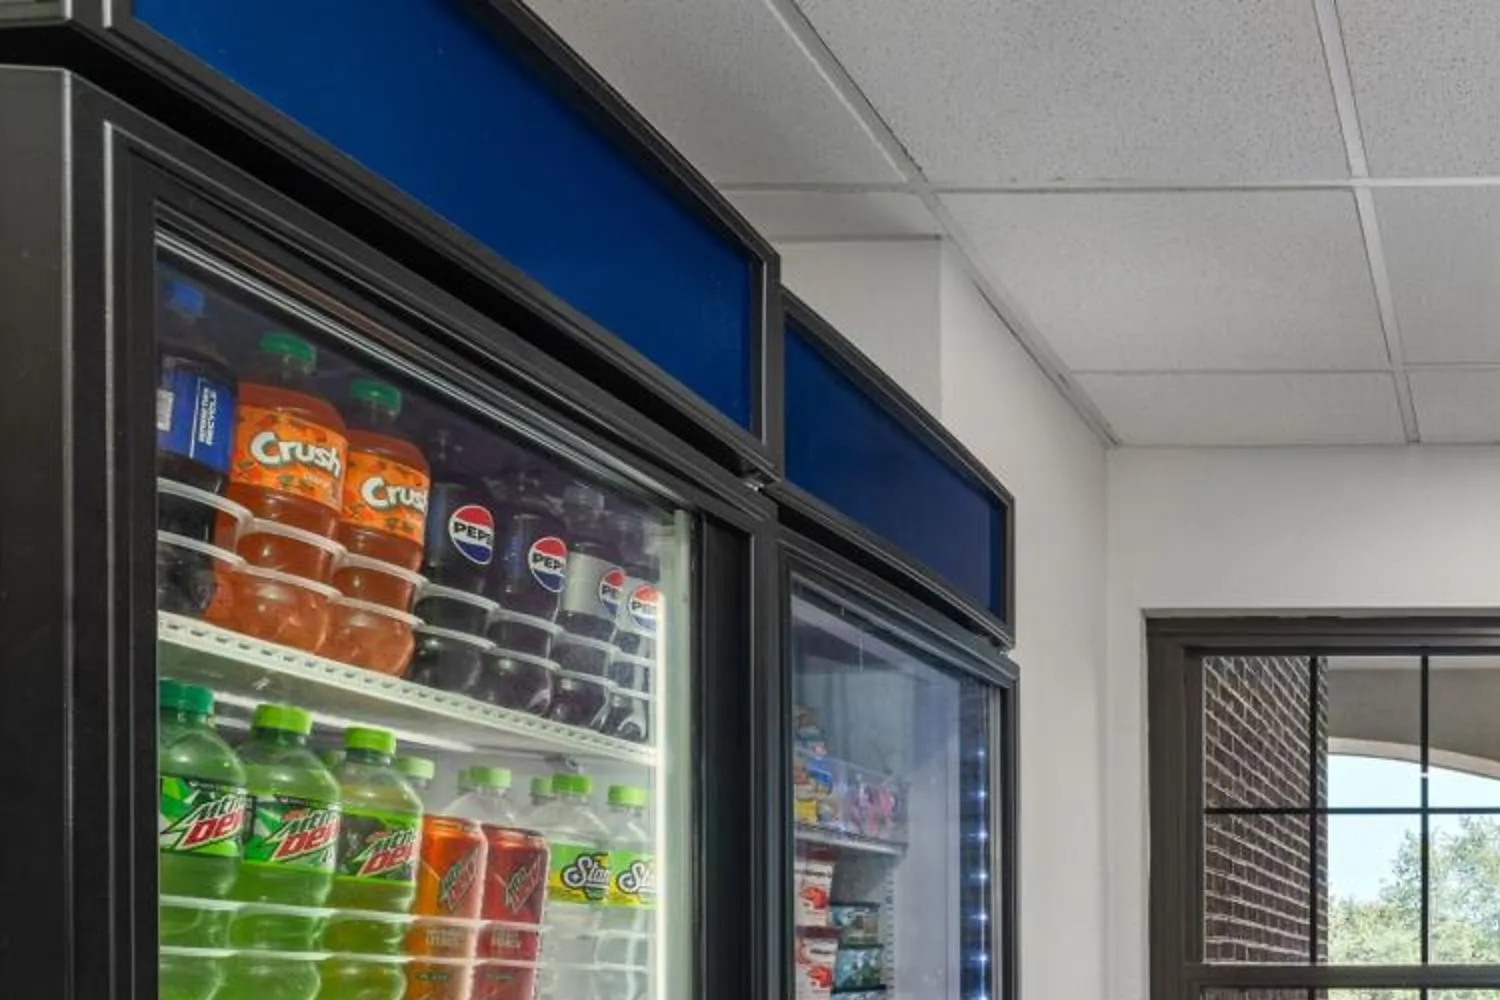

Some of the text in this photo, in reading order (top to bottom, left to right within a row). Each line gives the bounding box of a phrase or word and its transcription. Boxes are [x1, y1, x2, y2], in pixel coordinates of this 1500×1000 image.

[251, 431, 341, 478] Crush
[361, 475, 429, 514] Crus
[453, 521, 493, 546] PEPS
[532, 553, 566, 571] PEP
